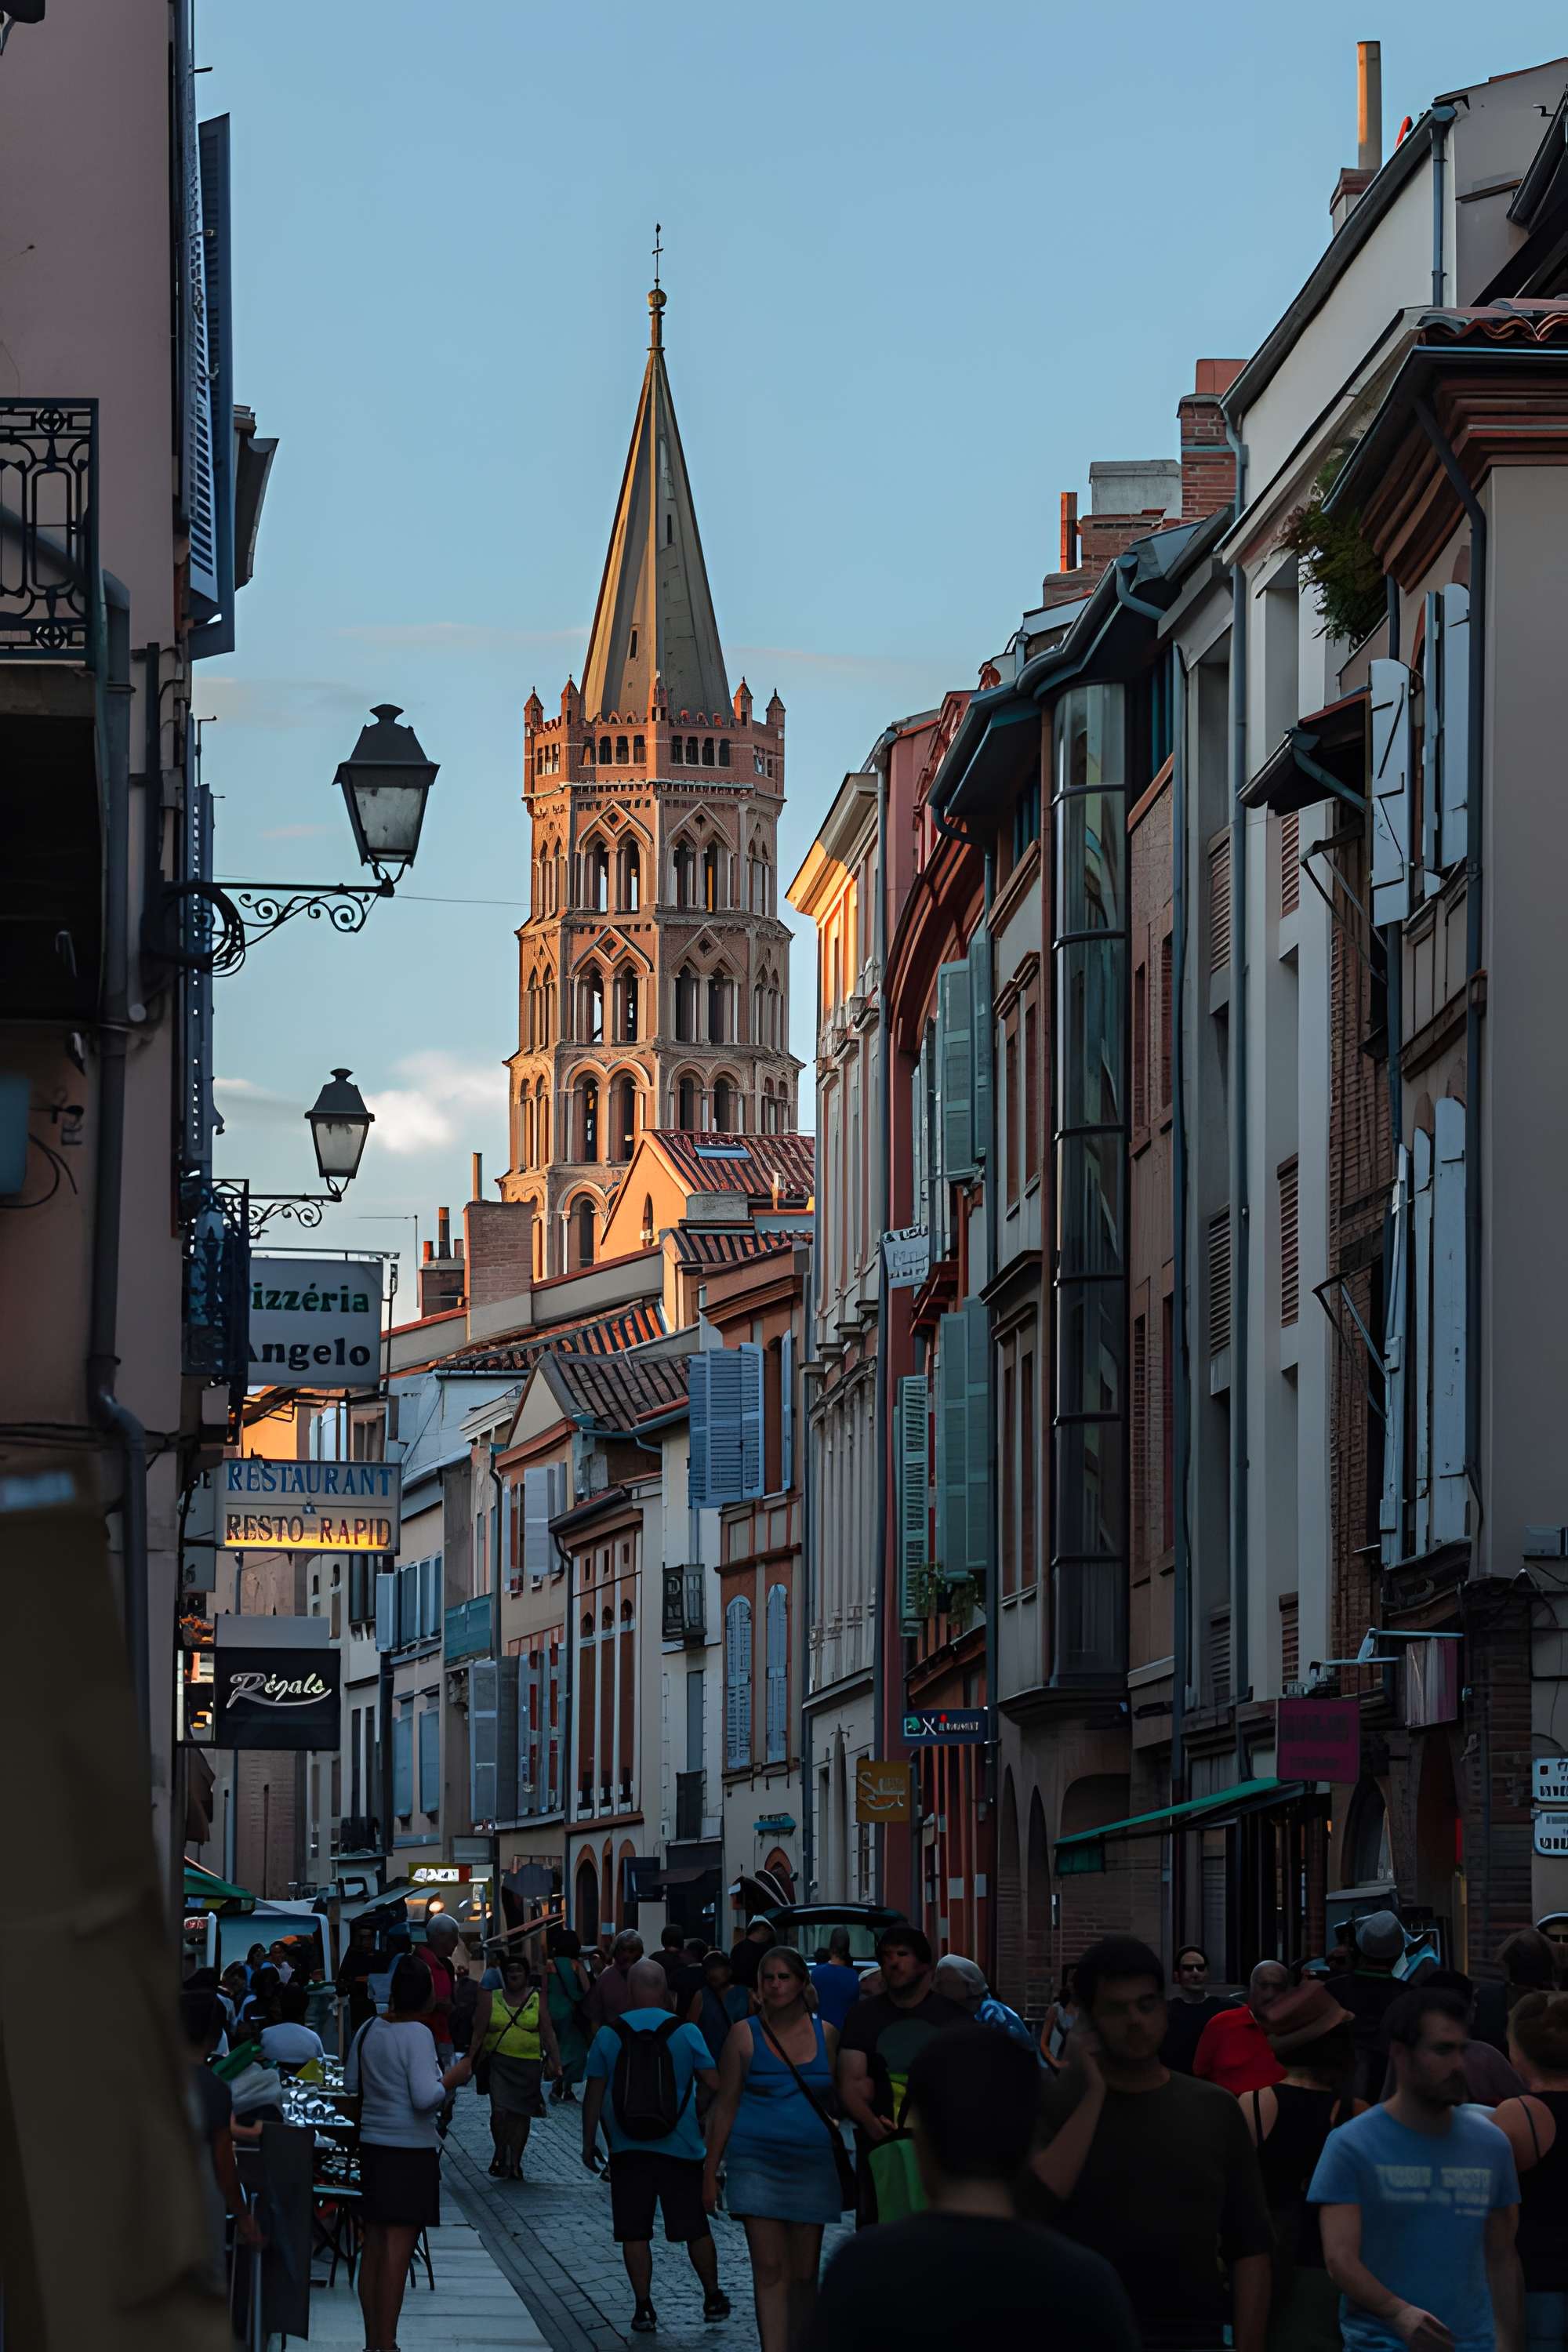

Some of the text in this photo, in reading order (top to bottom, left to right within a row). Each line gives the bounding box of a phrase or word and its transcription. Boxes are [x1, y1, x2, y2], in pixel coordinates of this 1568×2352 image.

[252, 1282, 369, 1312] izzéria
[228, 1463, 392, 1496] RESTAURANT
[226, 1514, 391, 1546] RESTO RAPID
